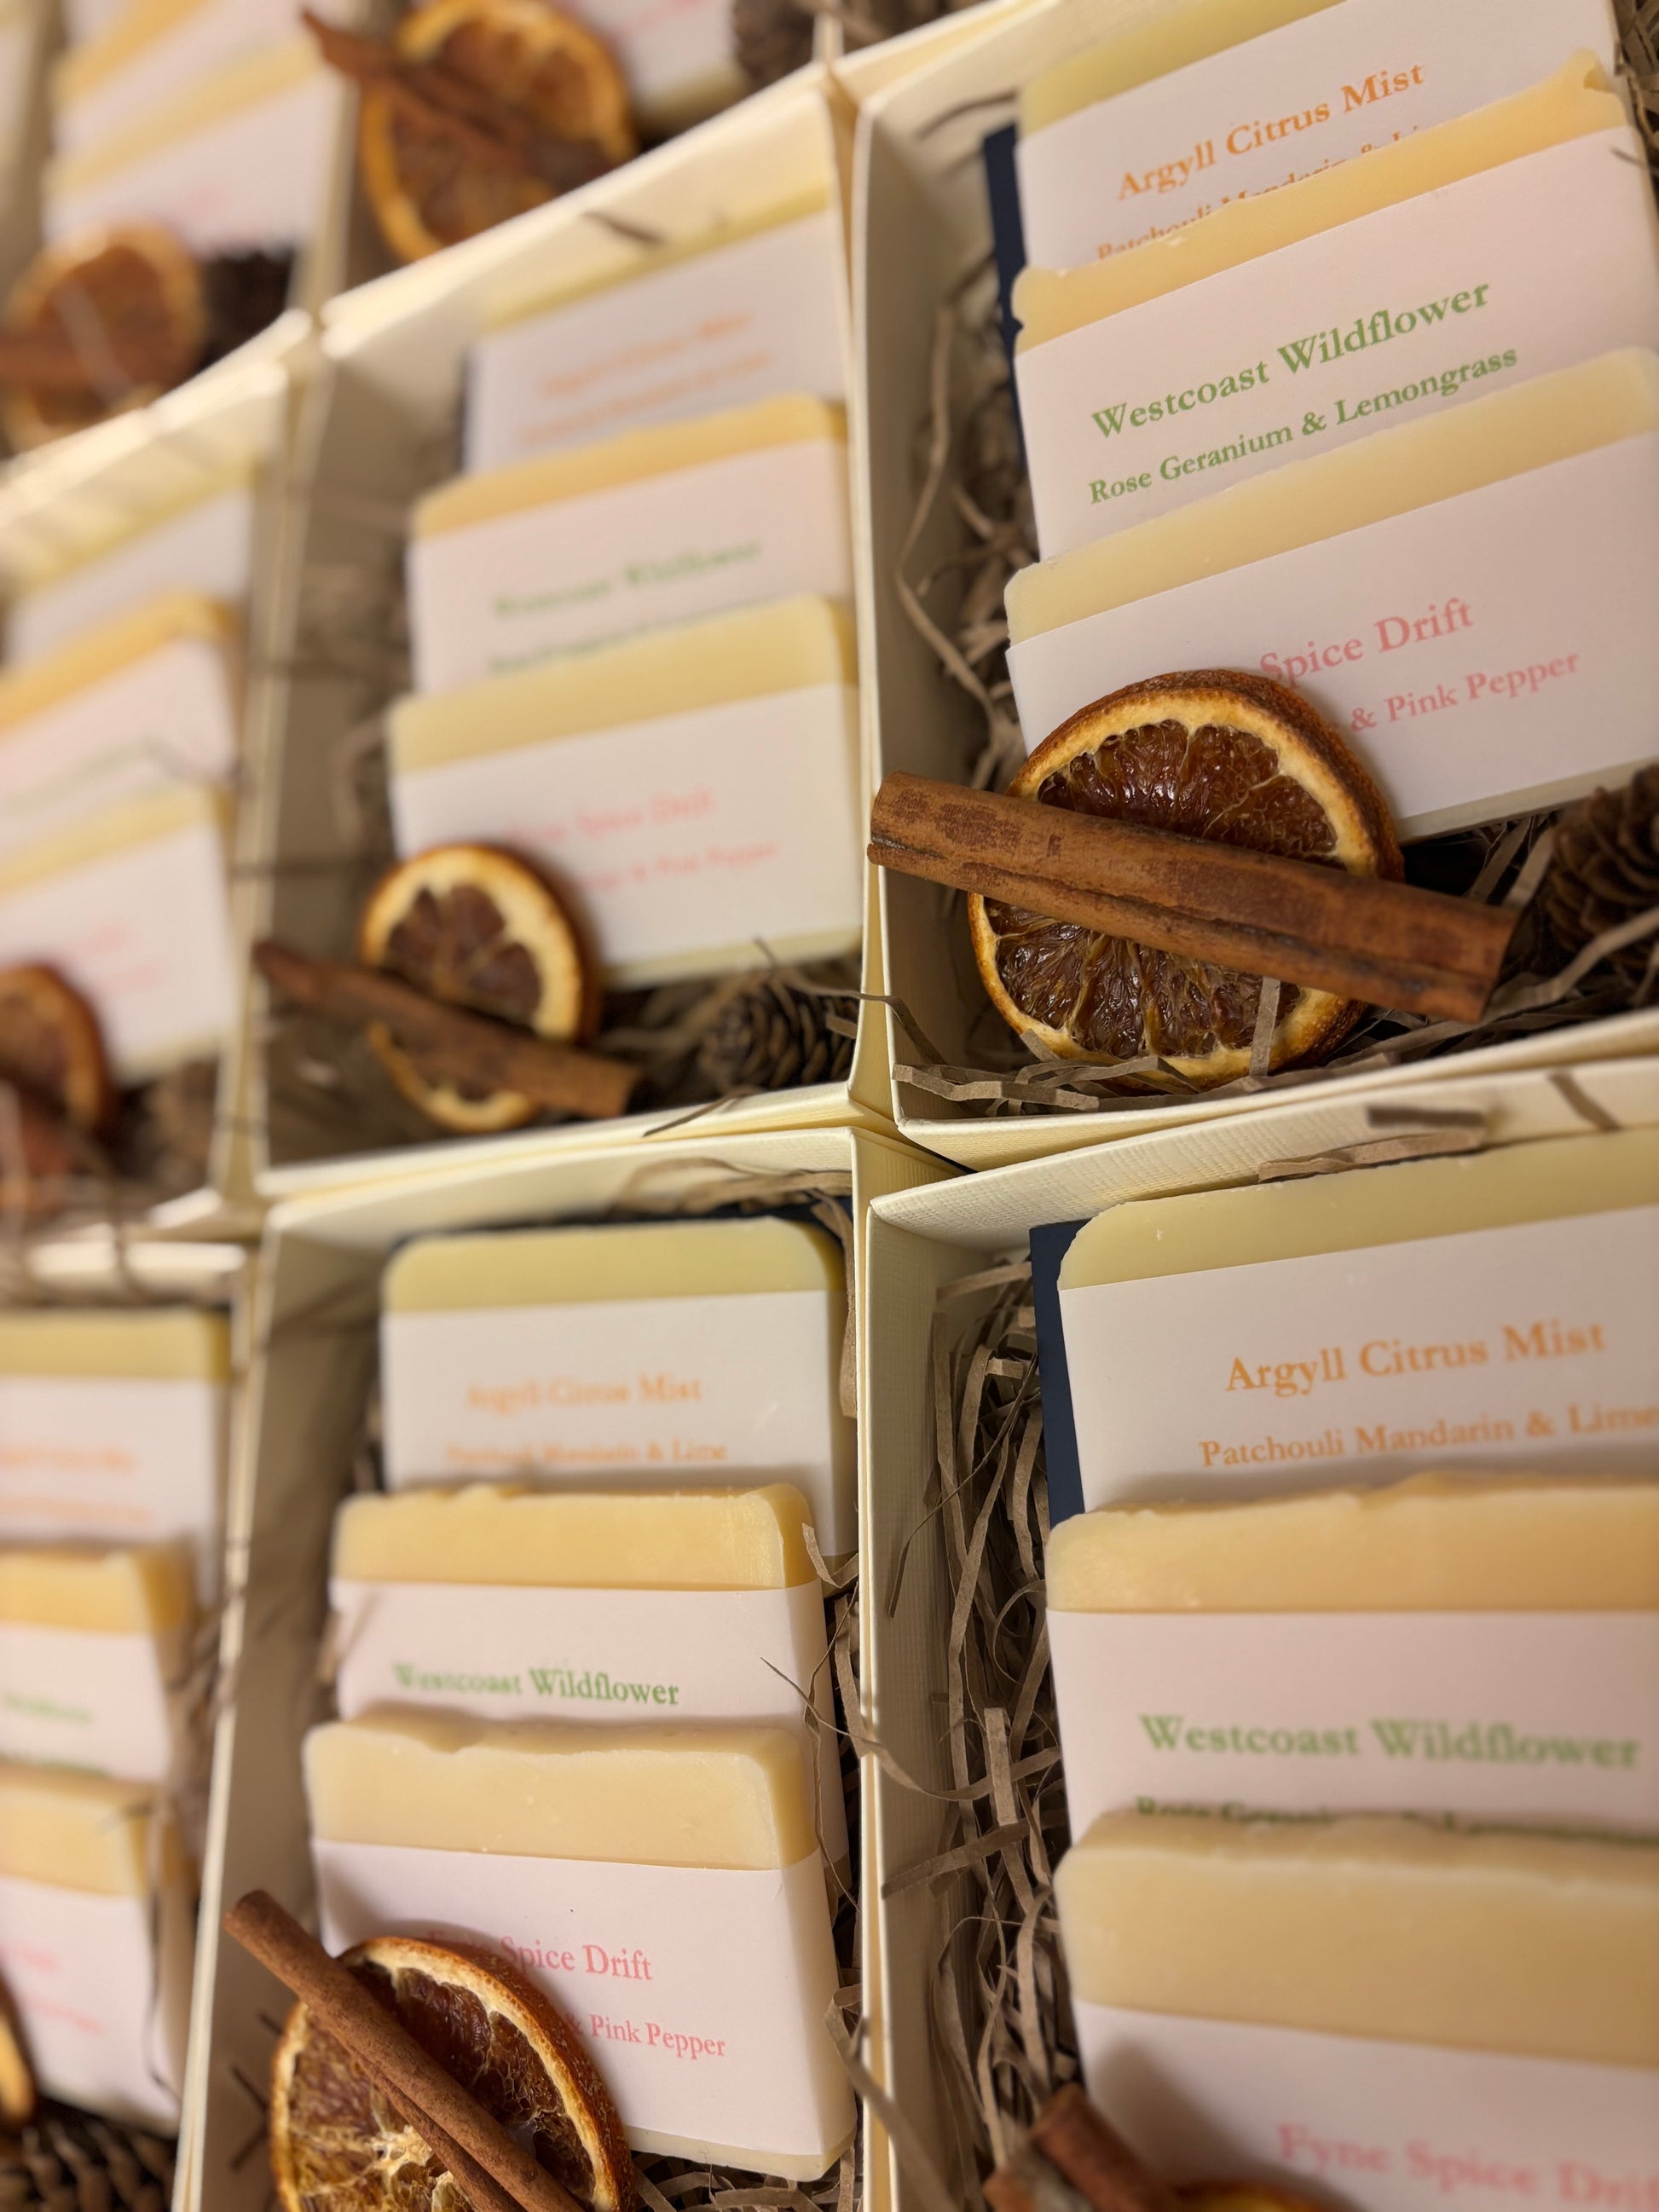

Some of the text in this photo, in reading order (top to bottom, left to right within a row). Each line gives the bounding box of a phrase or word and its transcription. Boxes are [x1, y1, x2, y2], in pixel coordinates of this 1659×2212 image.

[1119, 139, 1217, 201] Argyll
[1225, 101, 1331, 157] Citrus
[1339, 64, 1425, 113] Mist
[1090, 282, 1490, 440] Westcoast Wildflower
[1088, 348, 1518, 505] Rose Geranium & Lemongrass
[1259, 597, 1475, 690] Spice Drift
[1350, 654, 1580, 732] & Pink Pepper
[1224, 1319, 1606, 1398] Argyll Citrus Mist
[1199, 1429, 1344, 1468] Patchouli
[1354, 1414, 1515, 1455] Mandarin
[1524, 1409, 1558, 1438] &
[528, 1667, 680, 1706] Wildflower
[1138, 1713, 1643, 1770] Westcoast Wildflower
[582, 1943, 654, 1982] Drift
[589, 2013, 642, 2045] Pink
[644, 2021, 727, 2061] Pepper
